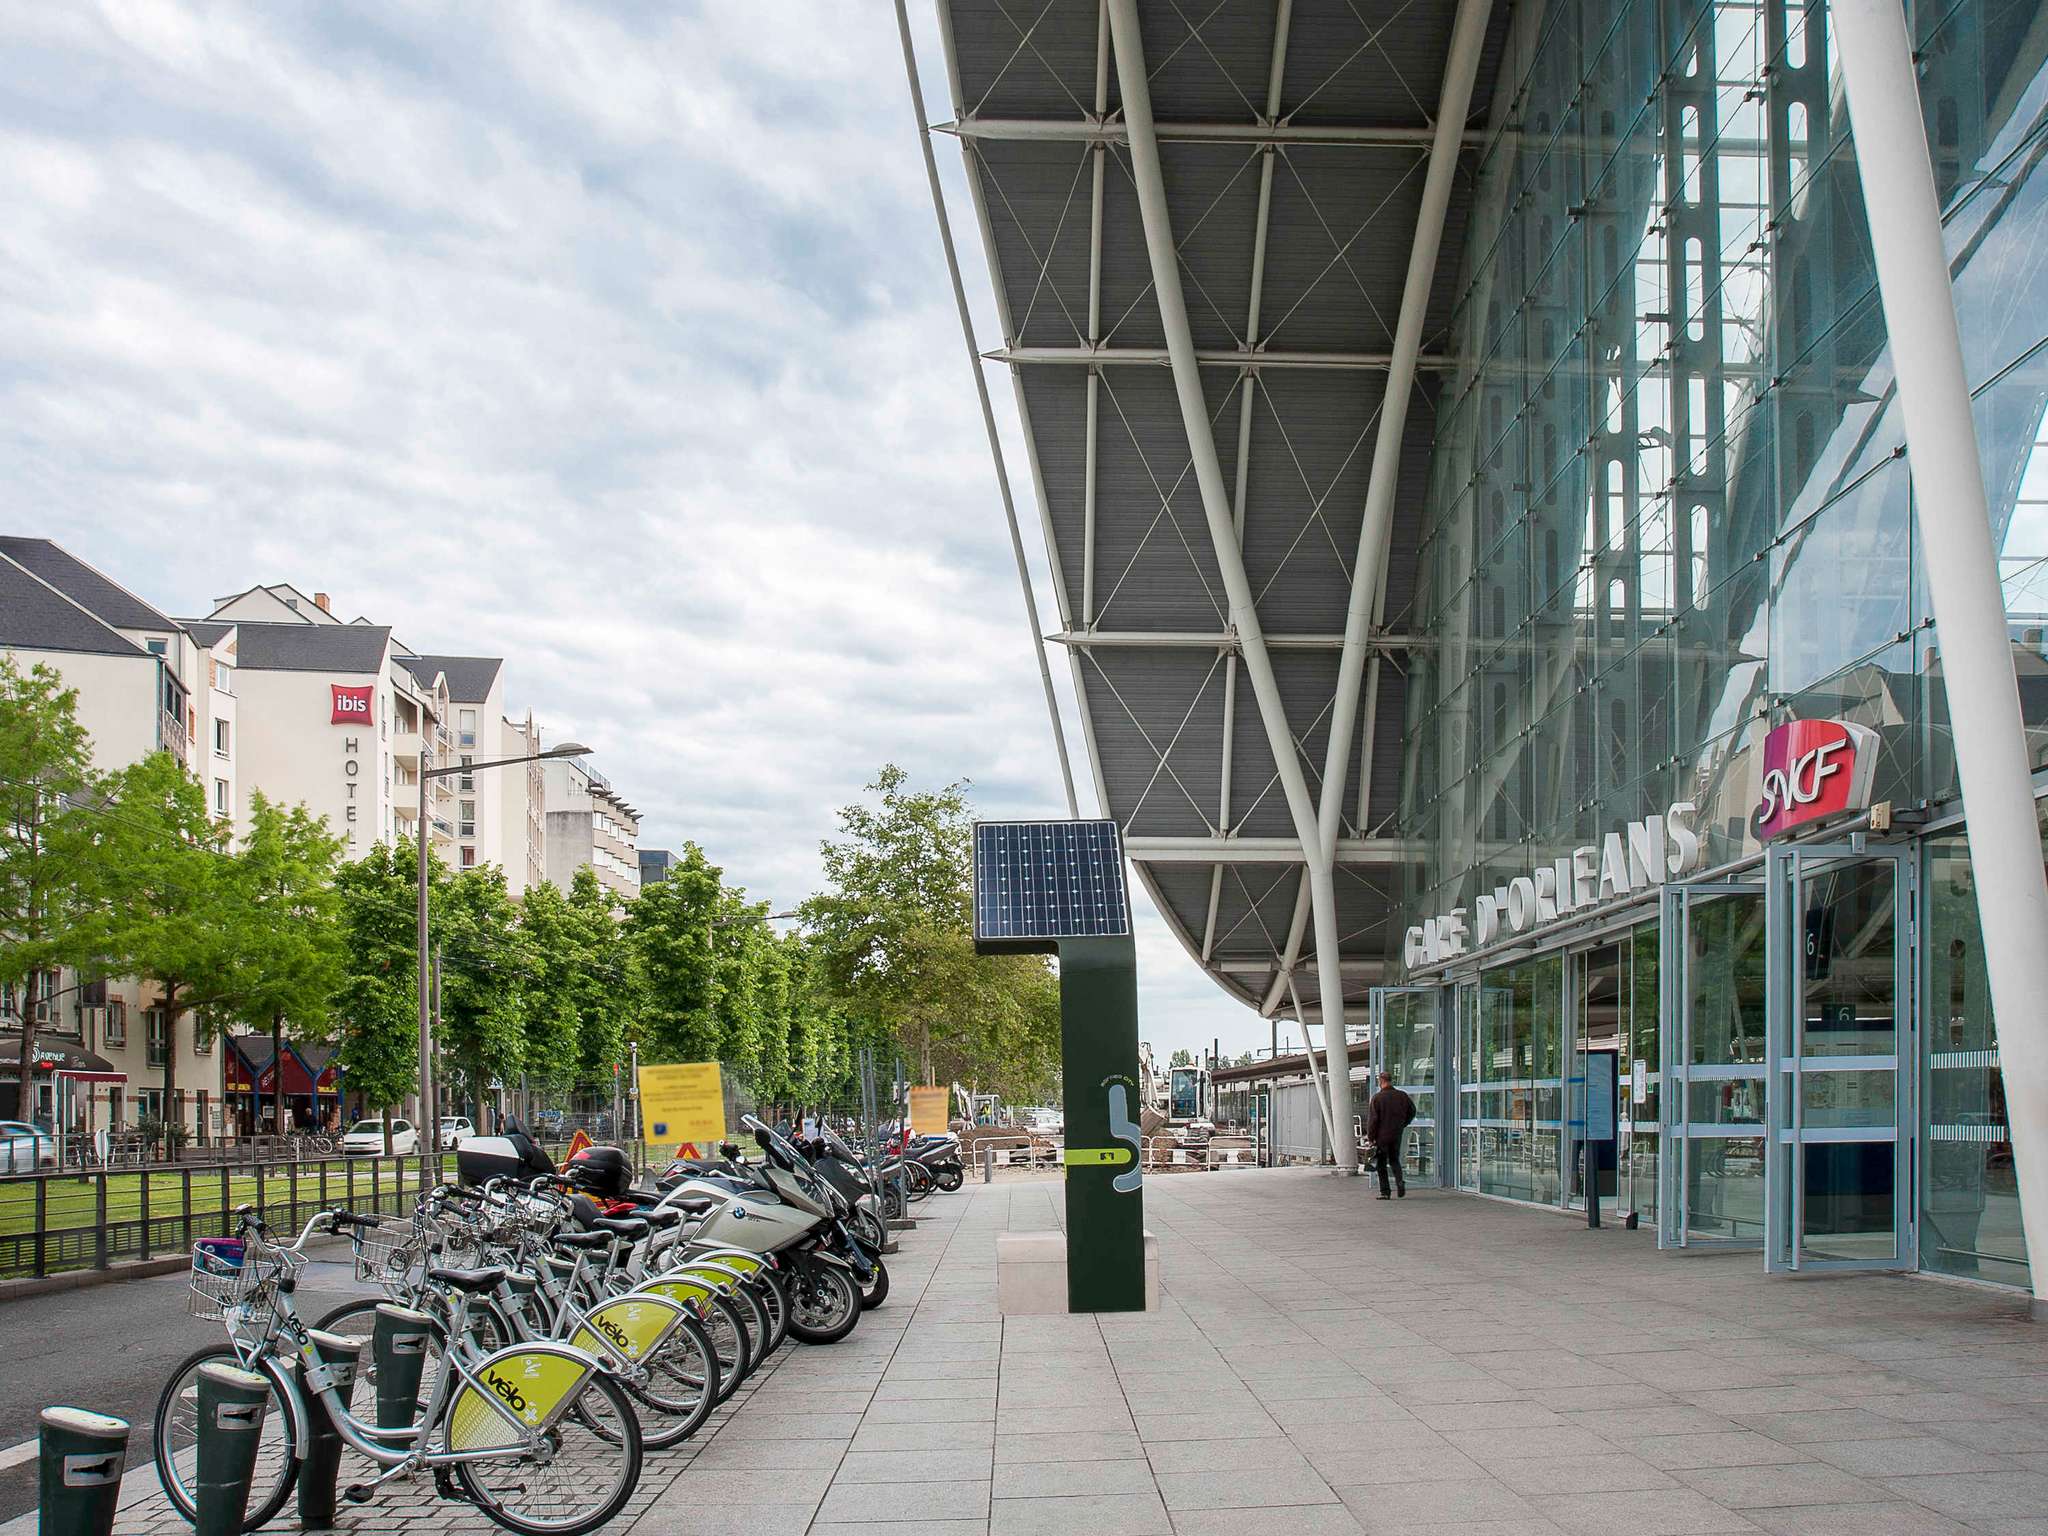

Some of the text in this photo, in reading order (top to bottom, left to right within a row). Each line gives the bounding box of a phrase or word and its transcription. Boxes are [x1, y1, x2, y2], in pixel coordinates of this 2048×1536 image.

[336, 694, 367, 713] ibis
[345, 737, 359, 844] HOTEL
[1758, 738, 1847, 824] SNCF
[1405, 908, 1468, 970] GARE
